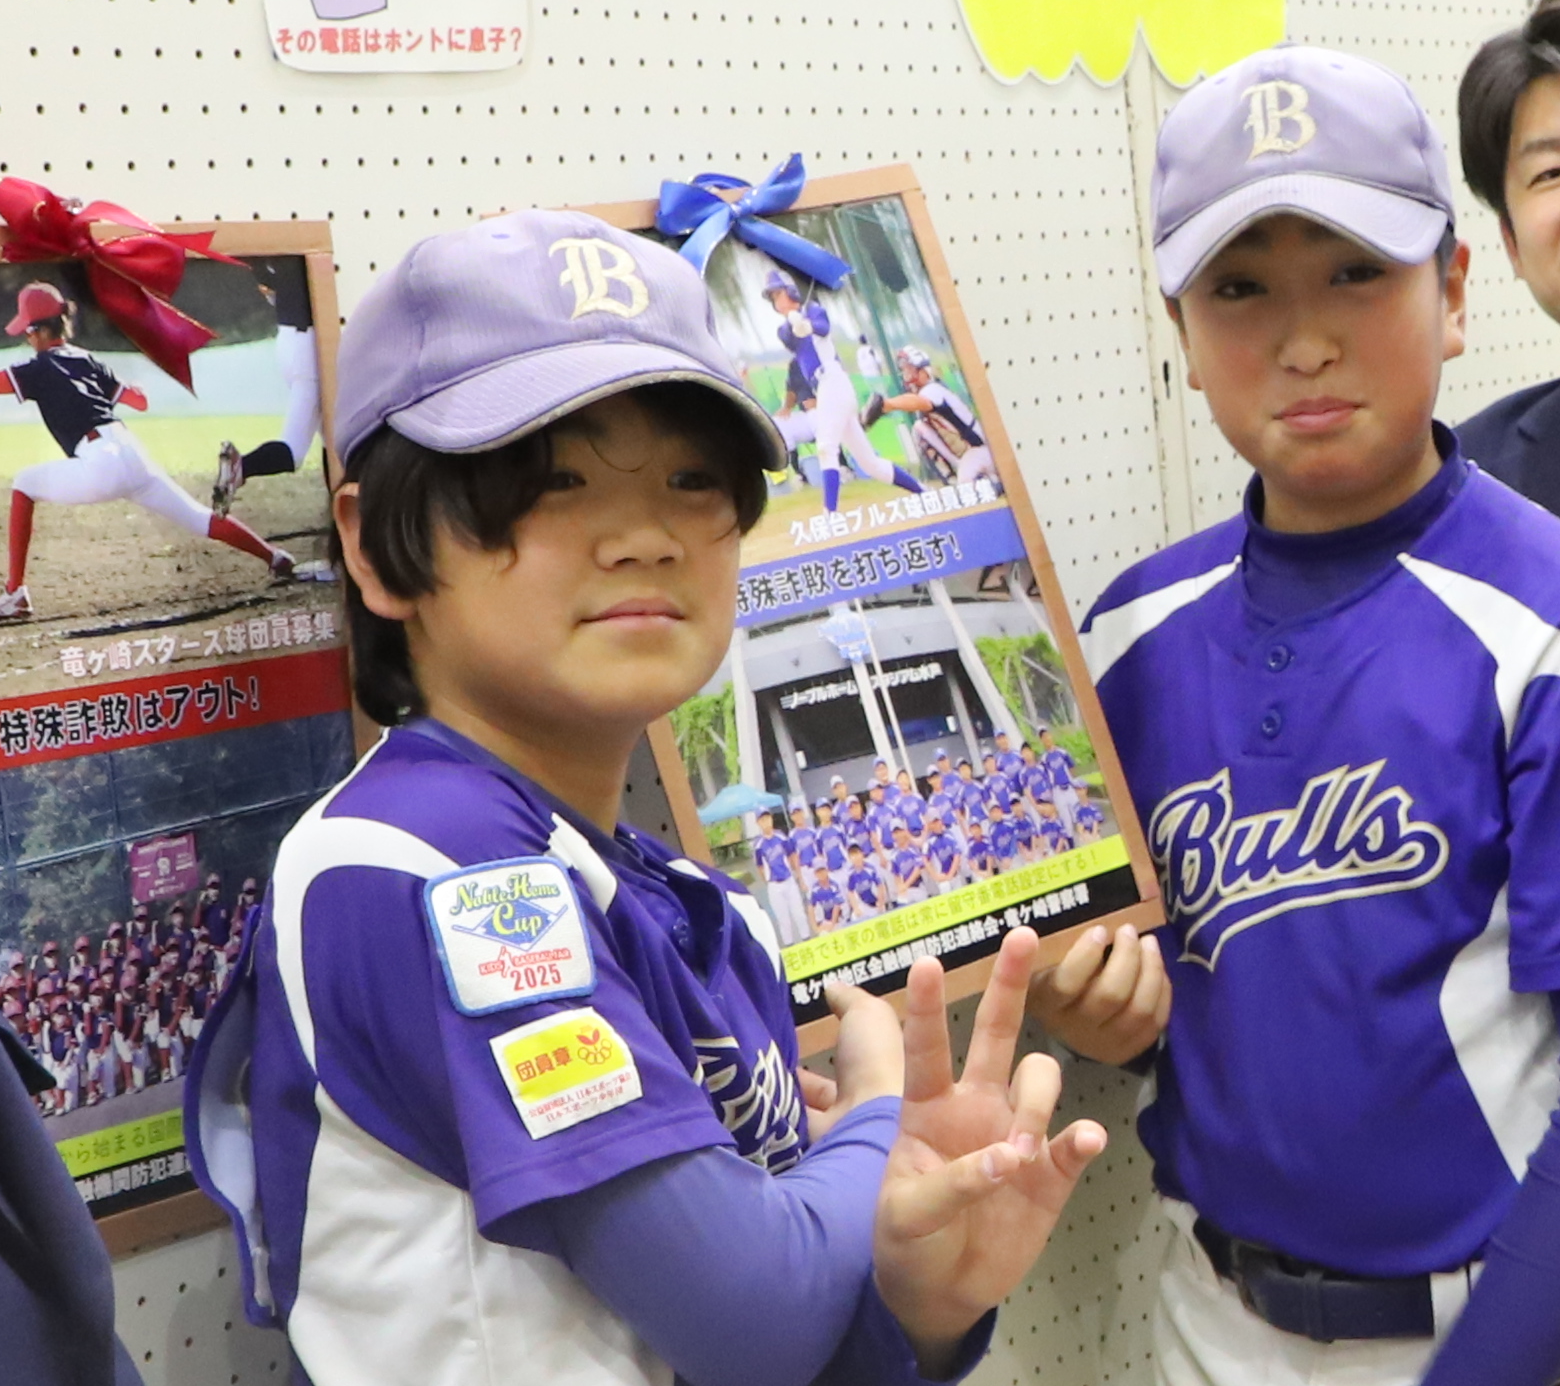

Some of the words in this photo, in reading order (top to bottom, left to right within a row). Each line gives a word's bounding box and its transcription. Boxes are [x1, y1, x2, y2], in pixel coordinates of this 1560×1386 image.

[275, 26, 523, 55] その電話はホントに息子？
[1241, 79, 1318, 163] B
[548, 237, 650, 321] B
[1149, 759, 1448, 931] Bulls
[492, 902, 542, 937] Cup
[510, 963, 562, 992] 2025
